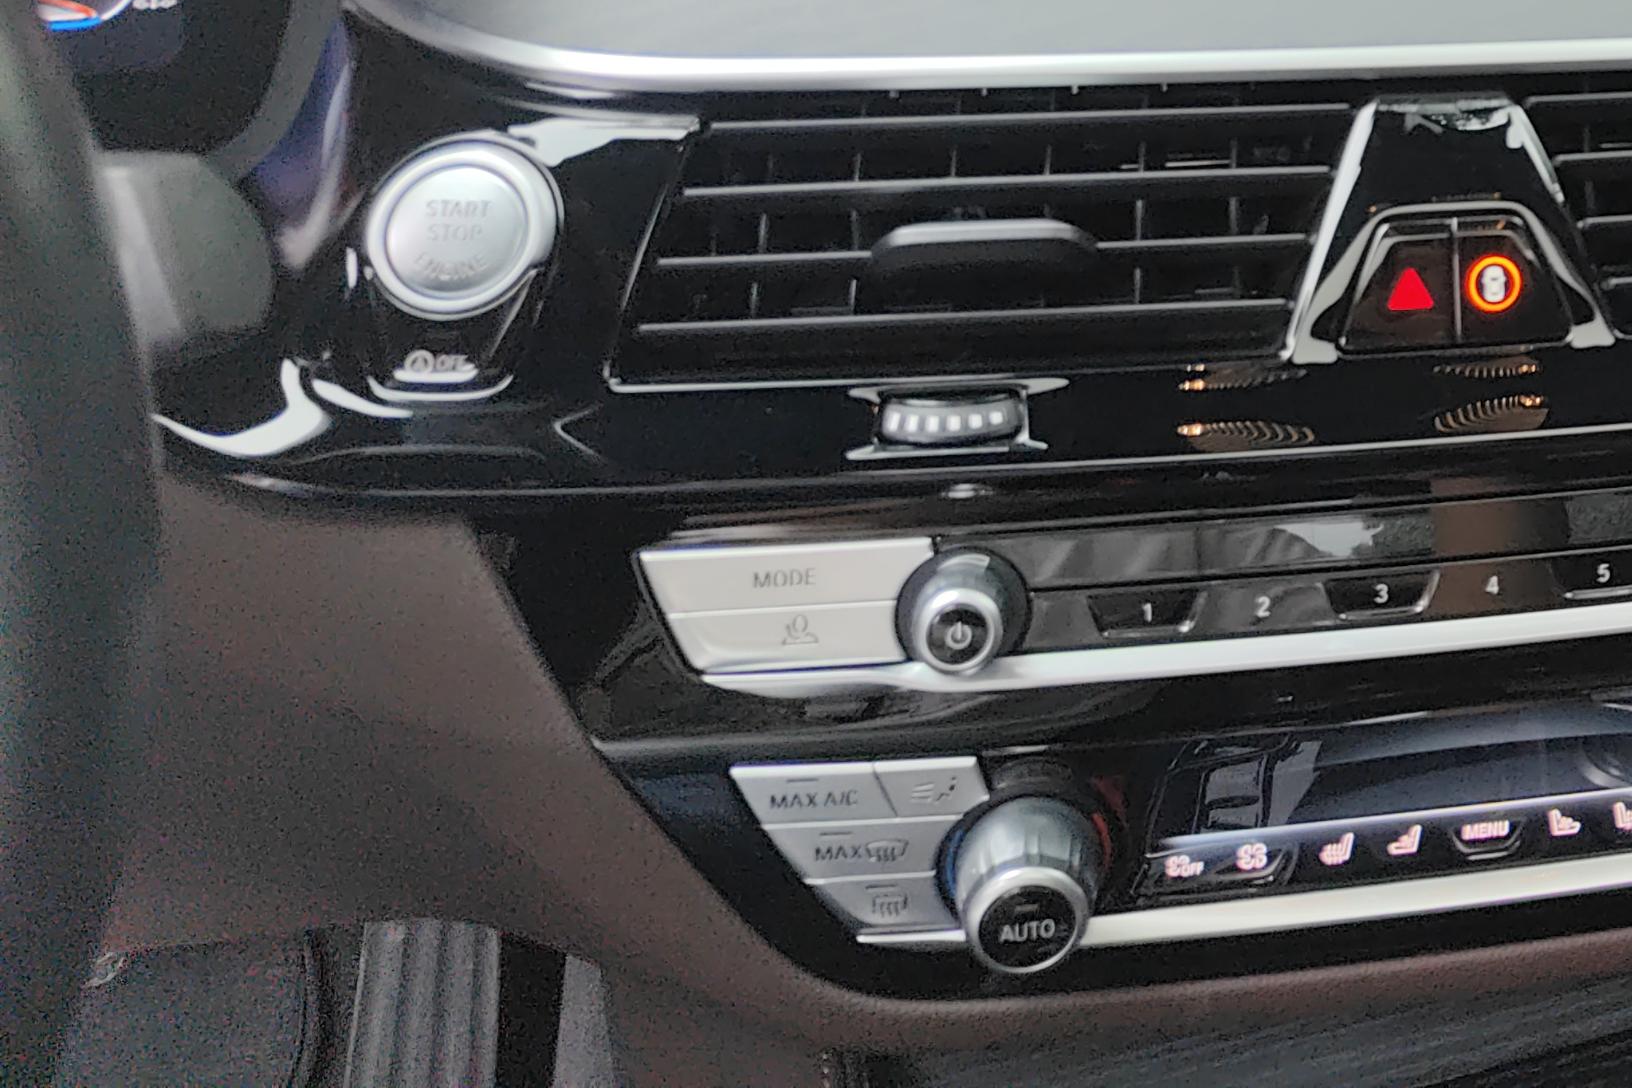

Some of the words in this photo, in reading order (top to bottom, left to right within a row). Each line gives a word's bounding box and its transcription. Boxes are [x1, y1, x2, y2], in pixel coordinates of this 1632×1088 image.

[425, 199, 493, 219] START
[426, 223, 484, 242] STOP
[753, 566, 817, 589] MODE
[1596, 562, 1611, 583] 5
[1373, 583, 1389, 604] 3
[1485, 575, 1499, 595] 4
[1142, 602, 1152, 622] 1
[1255, 596, 1271, 618] 2
[769, 792, 819, 809] MAX
[823, 789, 858, 807] A/C
[1461, 819, 1510, 841] MENU
[815, 844, 862, 862] MAX
[1000, 918, 1056, 944] AUTO
